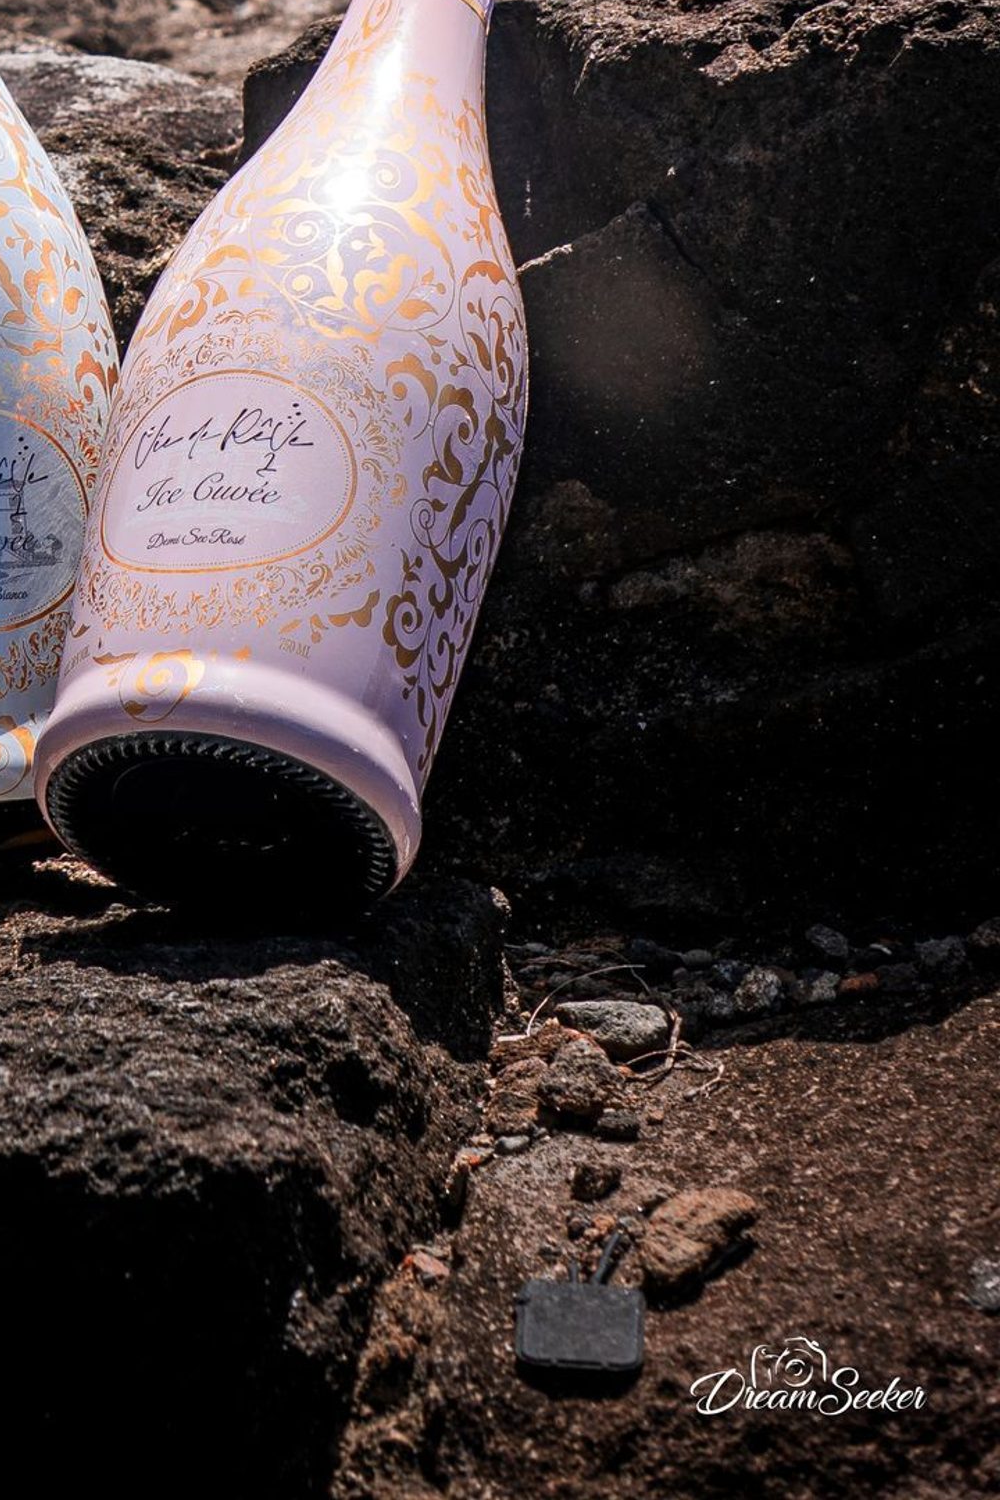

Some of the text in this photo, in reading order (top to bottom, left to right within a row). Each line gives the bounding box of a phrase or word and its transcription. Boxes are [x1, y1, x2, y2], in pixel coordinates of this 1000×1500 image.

[134, 415, 184, 470] Vie
[136, 472, 282, 512] Ice Cuvée
[146, 531, 180, 550] Demi
[208, 527, 247, 545] Rosé
